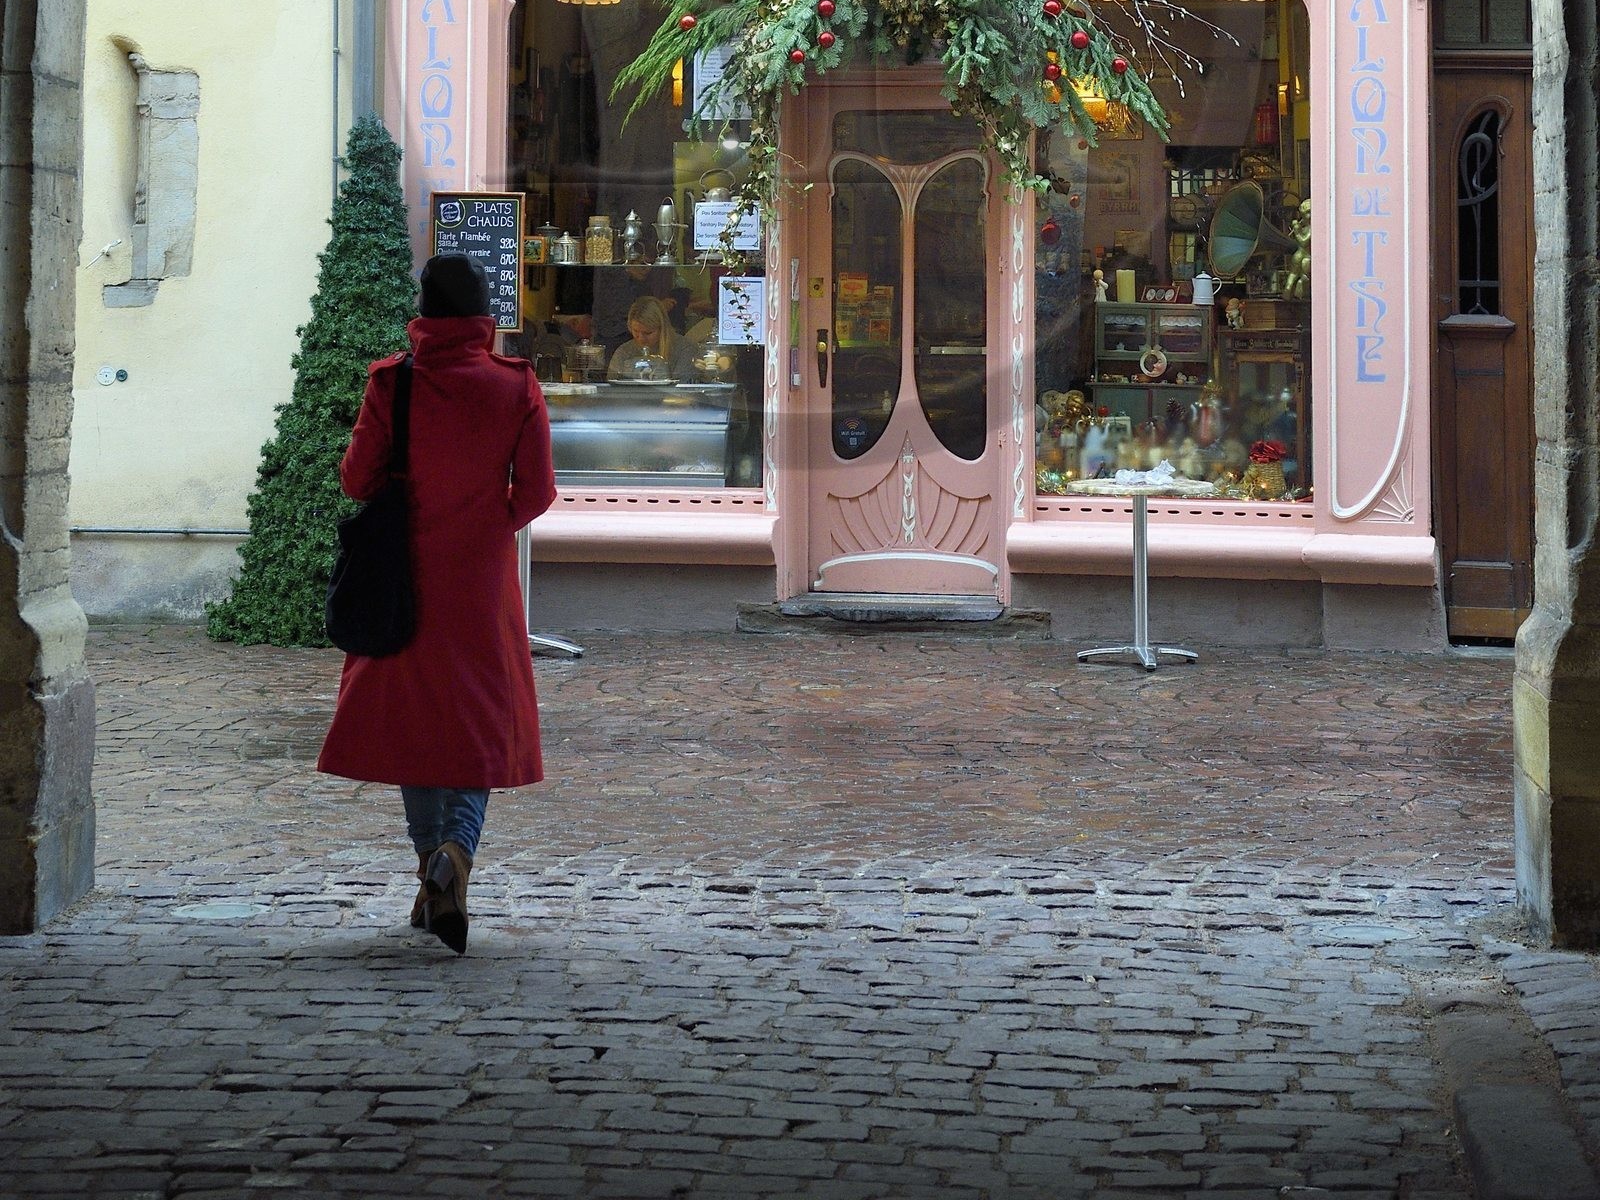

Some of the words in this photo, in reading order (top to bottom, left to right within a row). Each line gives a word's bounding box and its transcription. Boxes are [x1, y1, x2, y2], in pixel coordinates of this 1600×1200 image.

[474, 201, 512, 214] PLATS
[467, 215, 514, 228] CHAUDS
[437, 231, 456, 240] Tarte
[460, 231, 491, 241] Flambée
[1349, 230, 1389, 384] THE
